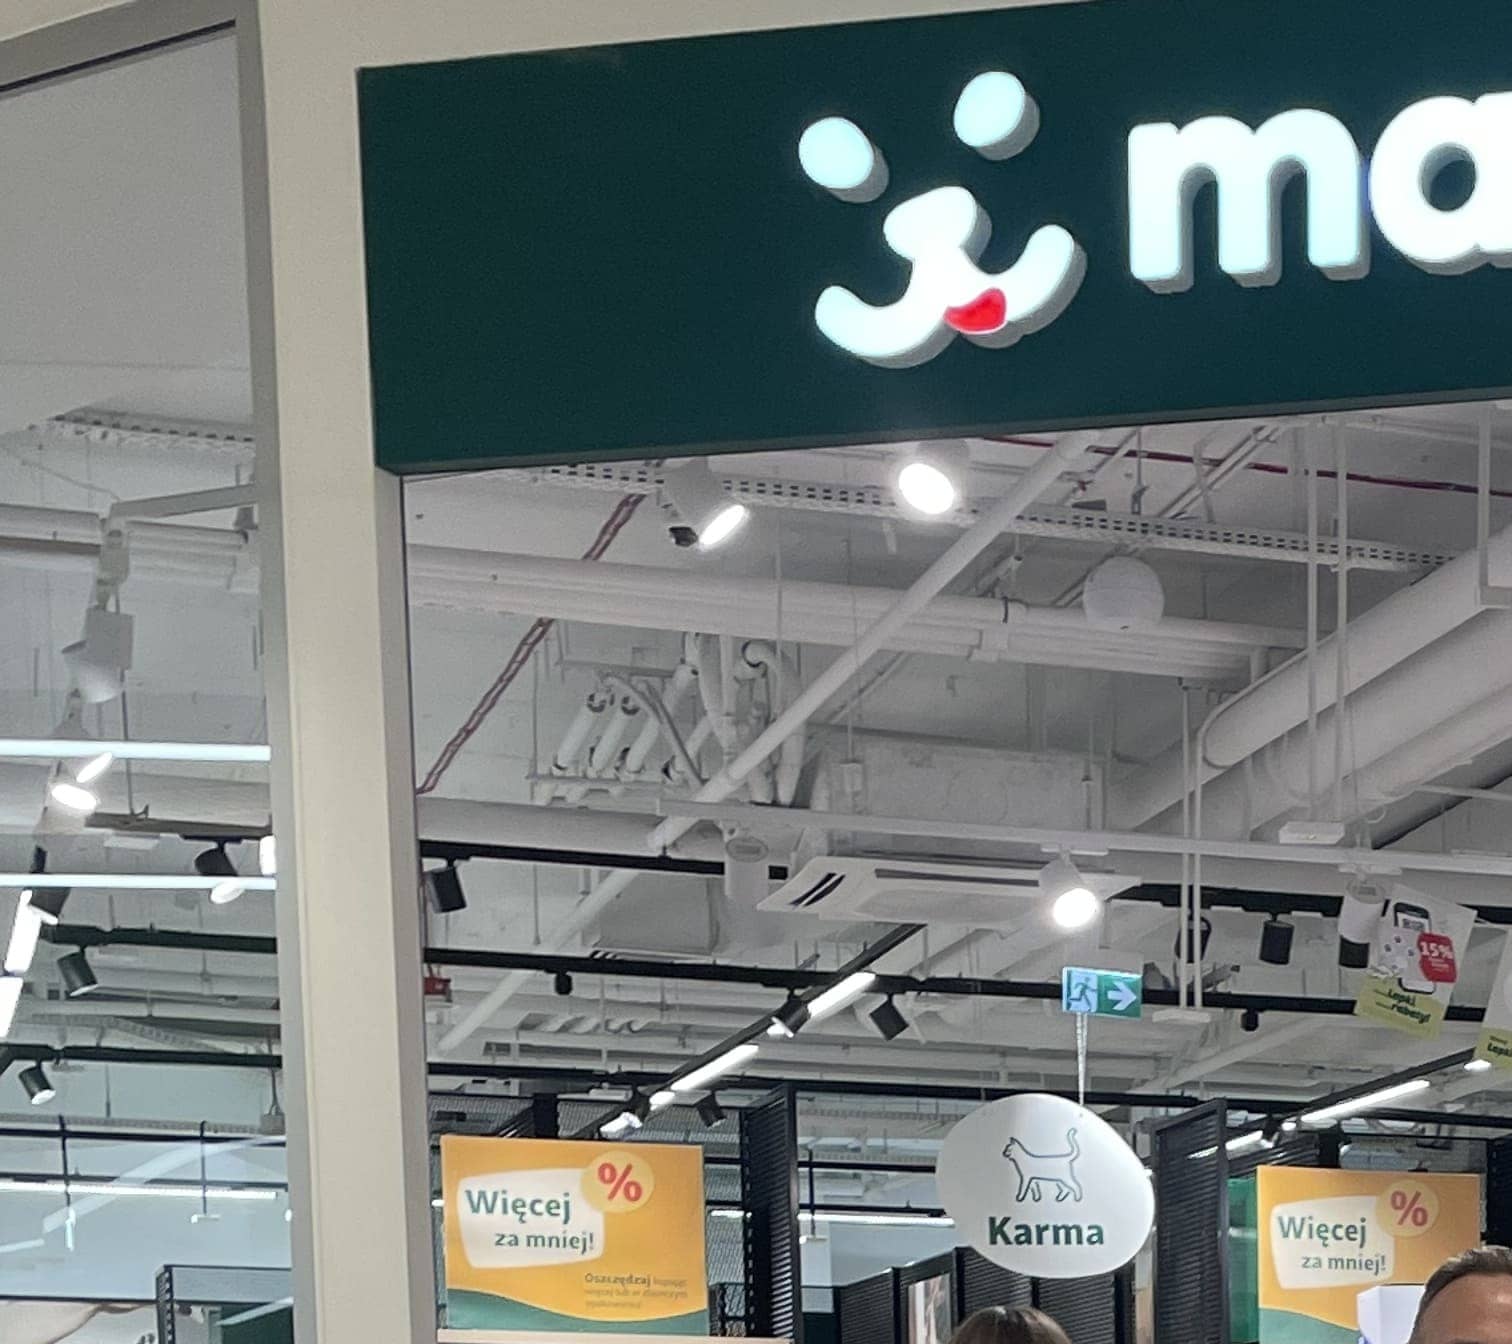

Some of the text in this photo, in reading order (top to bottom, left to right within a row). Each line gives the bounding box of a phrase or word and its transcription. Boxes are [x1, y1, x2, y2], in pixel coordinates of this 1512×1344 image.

[1420, 941, 1454, 959] 15%
[598, 1162, 644, 1202] %
[464, 1188, 572, 1224] Więcej
[1390, 1190, 1429, 1227] %
[494, 1232, 595, 1256] za mniej!
[988, 1216, 1104, 1246] Karma
[1277, 1215, 1367, 1249] Więcej
[1301, 1254, 1386, 1276] za mniej!
